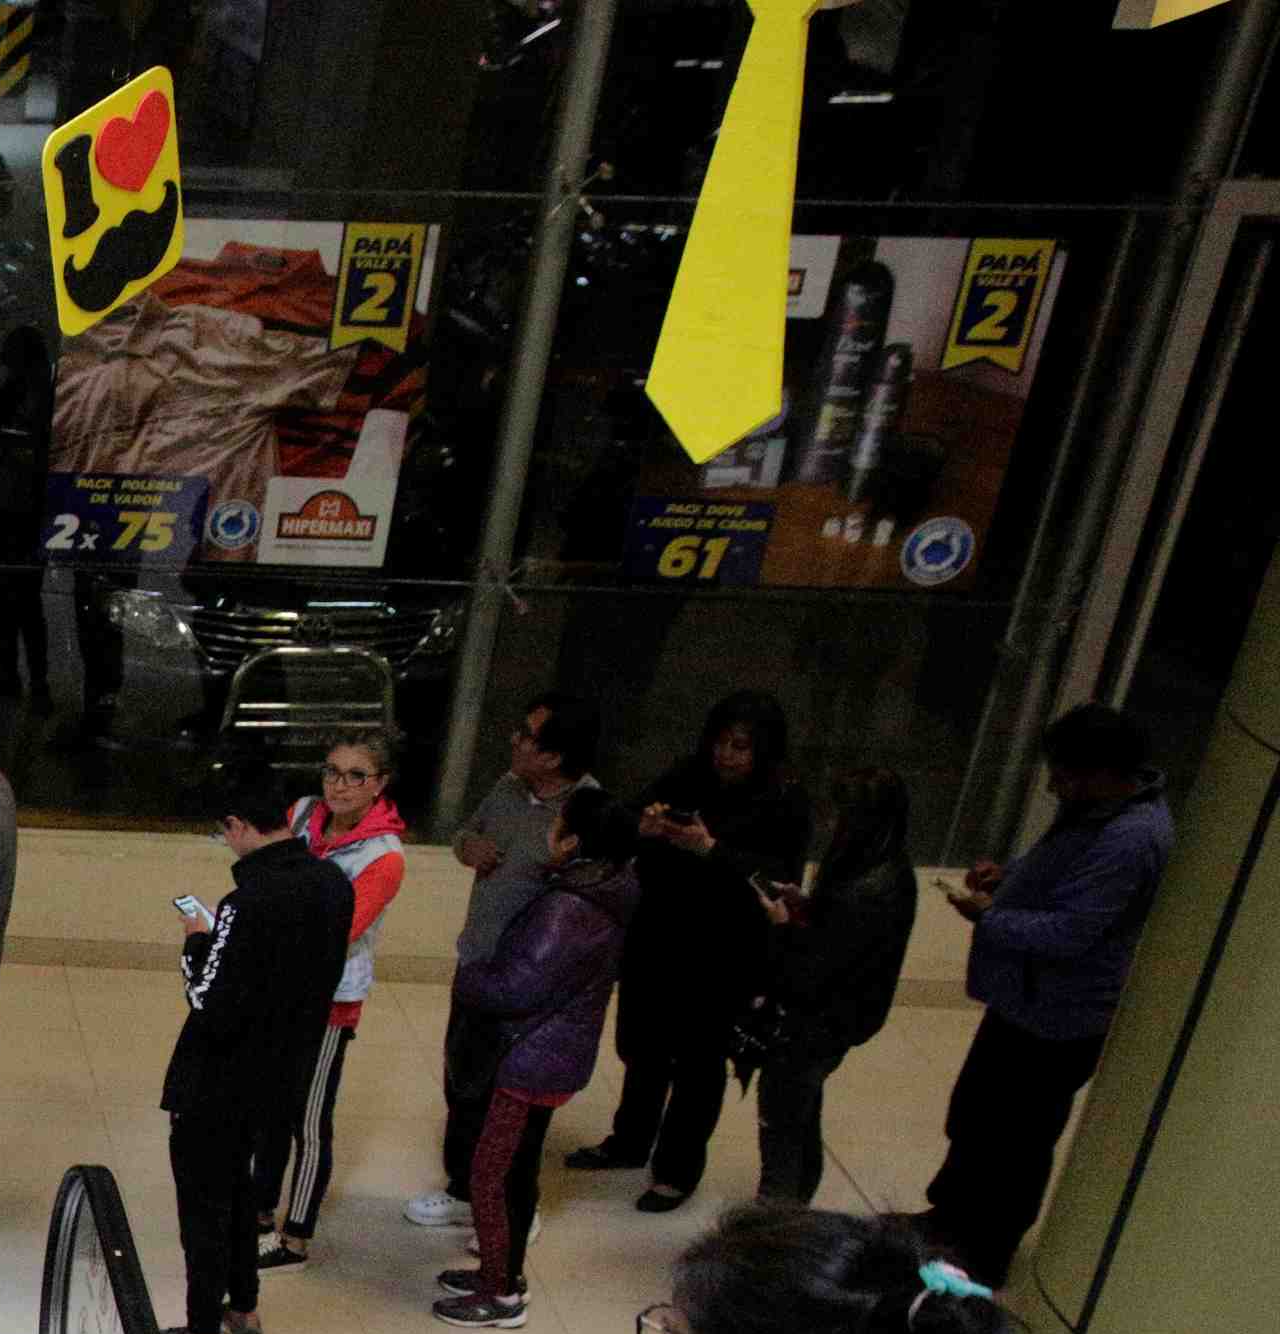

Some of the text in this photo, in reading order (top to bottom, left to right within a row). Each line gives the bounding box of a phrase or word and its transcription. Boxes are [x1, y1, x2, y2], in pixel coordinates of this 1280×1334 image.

[354, 232, 413, 254] PAPÁ
[977, 249, 1042, 272] PAPÁ
[349, 272, 397, 321] 2
[965, 288, 1019, 341] 2
[112, 511, 177, 552] 75
[279, 516, 371, 538] HIPERMAXI
[656, 534, 732, 579] 61
